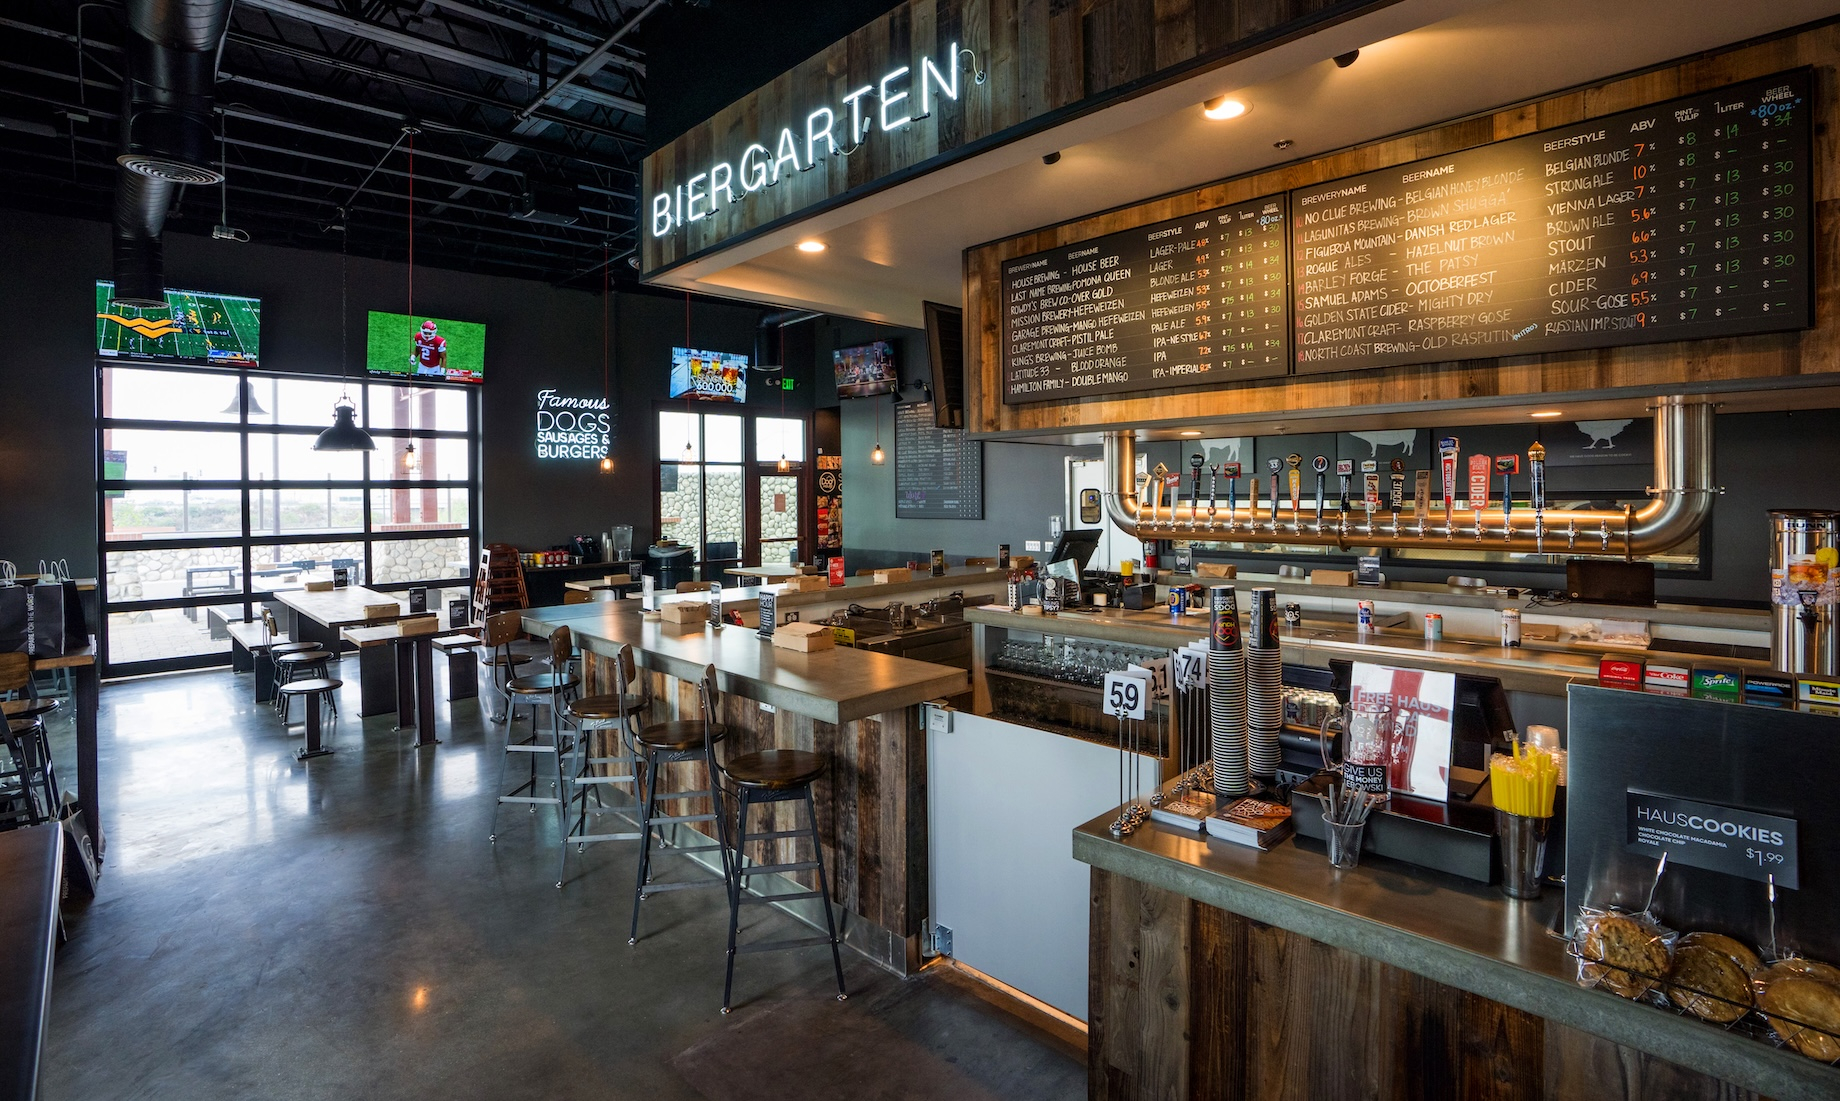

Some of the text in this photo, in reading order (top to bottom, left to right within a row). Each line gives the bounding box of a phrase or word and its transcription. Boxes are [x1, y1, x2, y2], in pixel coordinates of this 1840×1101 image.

[1761, 91, 1794, 103] WHEEL
[1766, 85, 1790, 96] BEER
[1721, 102, 1744, 113] LITER
[1630, 119, 1656, 132] ABV
[1676, 112, 1699, 122] TULIP
[653, 42, 958, 237] BIERGARTEN
[1544, 130, 1605, 152] BEERSTYLE
[1545, 149, 1630, 177] BELGIAN BLONDE
[1403, 165, 1454, 183] BEERNAME
[1545, 172, 1614, 196] STRONG ALE
[1301, 185, 1367, 205] BREWERYNAME
[1406, 184, 1448, 205] BELGIAN
[1547, 191, 1635, 216] VIENNA LAGER
[1262, 207, 1279, 215] WHEEL
[1305, 196, 1396, 225] NO CLUE BREWING
[1407, 203, 1449, 222] BROWN
[1195, 220, 1210, 230] ABV
[1305, 215, 1399, 242] LAGUNITAS BREWING
[1405, 212, 1517, 241] DANISH RED LAGER
[1547, 213, 1615, 235] BROWN ALE
[1148, 227, 1182, 241] BEERSTYLE
[1354, 233, 1396, 250] MOUNTAIN
[1406, 230, 1515, 258] HAZELNUT BROWN
[1548, 235, 1595, 256] STOUT
[1068, 247, 1099, 260] BEERNAME
[1008, 259, 1048, 274] BREWERYNAME
[1071, 256, 1120, 276] HOUSE BEER
[1150, 260, 1173, 273] LAGER
[1306, 254, 1371, 275] ROGUE ALES
[1406, 254, 1478, 276] THE PATSY
[1548, 256, 1606, 275] MÄRZEN
[1012, 271, 1060, 290] HOUSE BREWING
[1104, 269, 1131, 282] QUEEN
[1150, 270, 1196, 288] BLONDE ALE
[1305, 269, 1388, 294] BARLEY FORGE
[1406, 271, 1497, 296] OCTOBERFEST
[1011, 285, 1045, 303] LAST NAME
[1092, 286, 1113, 299] GOLD
[1151, 287, 1194, 303] HEFEWEIZEN
[1549, 277, 1597, 296] CIDER
[1040, 297, 1058, 309] BREW
[1305, 288, 1388, 309] SAMUEL ADAMS
[1419, 290, 1493, 311] MIGHTY DRY
[1151, 303, 1195, 318] HEFEWEIZEN
[1304, 311, 1344, 327] GOLDEN
[1347, 306, 1378, 321] STATE
[1011, 313, 1040, 327] MISSION
[1012, 311, 1146, 342] GARAGE HEFEWEIZEN
[1151, 319, 1186, 334] PALE ALE
[1408, 309, 1512, 332] RASPBERRY GOSE
[1545, 319, 1588, 336] RUSSIAN
[1095, 328, 1114, 341] PALE
[1180, 332, 1198, 342] STYLE
[1304, 326, 1366, 345] CLAREMONT
[1422, 329, 1515, 350] OLD RASPUTIN
[1011, 339, 1048, 354] CLAREMONT
[1073, 343, 1118, 358] JUICE BOMB
[1305, 346, 1338, 361] NORTH
[1340, 343, 1372, 357] COAST
[1011, 352, 1066, 367] KING'S BREWING
[1071, 357, 1127, 373] BLOOD ORANGE
[1154, 351, 1167, 362] IPA
[1011, 366, 1049, 381] LATITUDE 33
[1072, 372, 1128, 387] DOUBLE MANGO
[782, 378, 794, 390] EXIT
[1011, 378, 1064, 394] HAMILTON FAMILY
[538, 389, 610, 410] Famous
[537, 411, 610, 433] DOGS
[537, 432, 610, 444] SAUSAGES &
[538, 444, 608, 459] BURGERS
[1392, 481, 1402, 507] ROGUE
[1471, 475, 1486, 507] CIDER
[1182, 655, 1201, 681] 74
[1703, 677, 1731, 686] Sprite
[1747, 680, 1791, 688] POWERADE
[1110, 681, 1139, 711] 59
[1358, 690, 1441, 712] FREE HAUS
[1344, 763, 1383, 776] GIVE US
[1344, 772, 1354, 780] THE
[1637, 806, 1784, 846] HAUSCOOKIES
[1638, 826, 1727, 848] WHITE CHOCOLATE MACADAMIA
[1638, 832, 1686, 845] CHOCOLATE CHIP
[1638, 837, 1659, 846] ROYALE
[1746, 848, 1784, 866] $1.99
